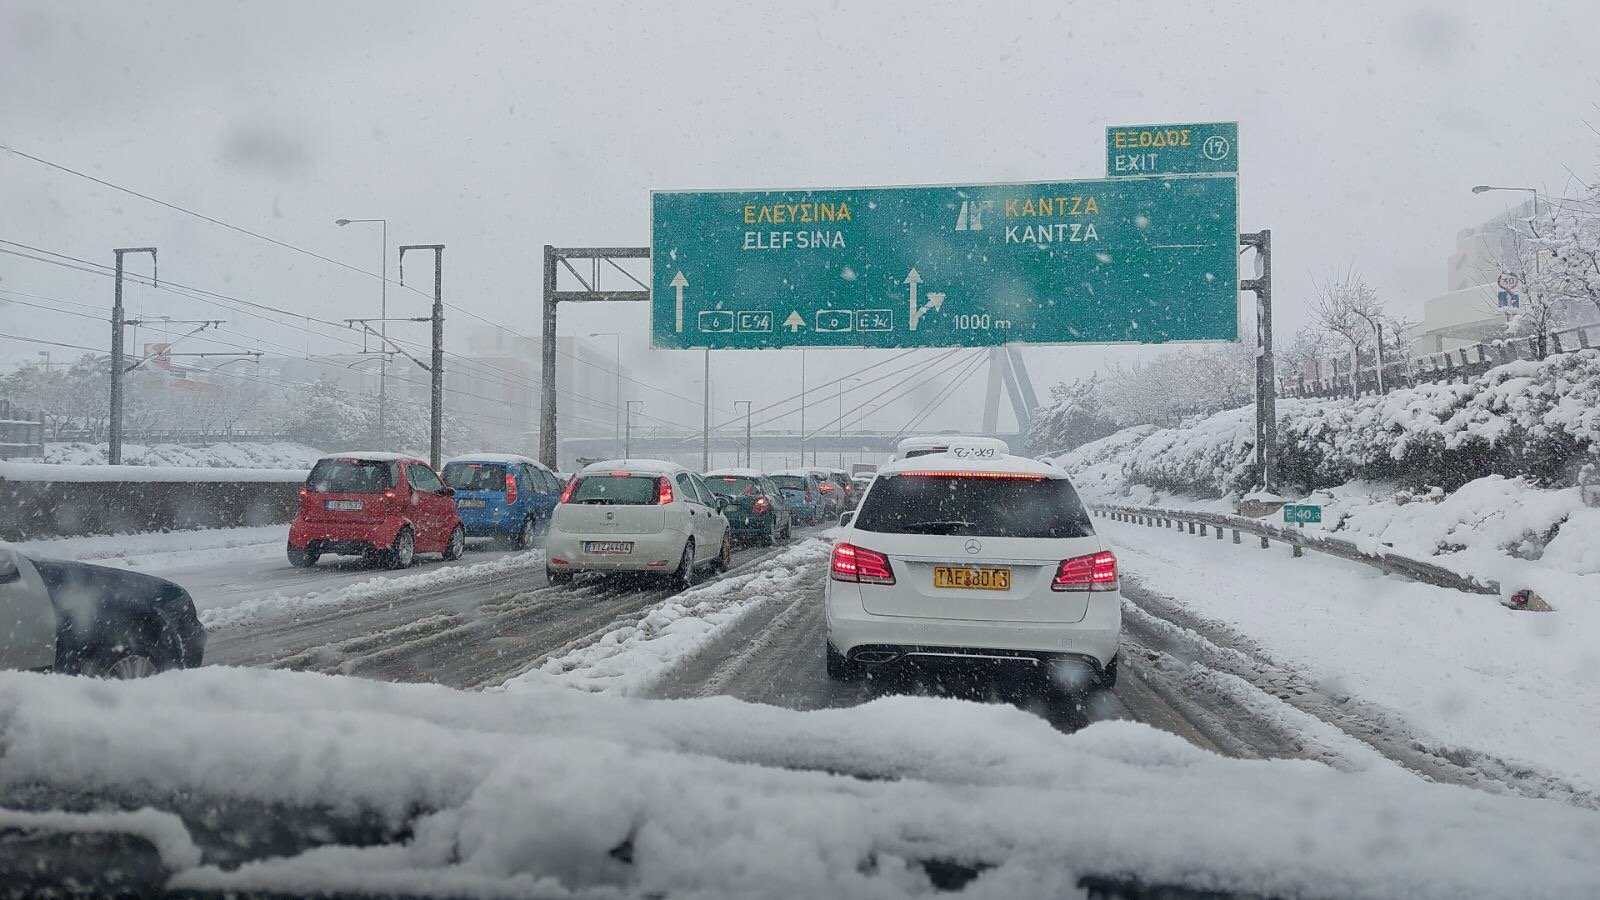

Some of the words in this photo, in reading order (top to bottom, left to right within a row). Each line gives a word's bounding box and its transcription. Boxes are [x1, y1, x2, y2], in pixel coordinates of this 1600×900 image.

[1115, 129, 1192, 149] ΕΞΟΔΟΣ
[1208, 141, 1224, 155] 17
[1115, 153, 1159, 171] EXIT
[744, 202, 852, 224] ΕΛΕΥΣΙΝΑ
[1005, 196, 1099, 217] ΚΑΝΤΖΑ
[743, 230, 847, 250] ELEFSINA
[1005, 222, 1100, 243] KANTZA
[712, 316, 720, 328] 6
[954, 314, 990, 330] 1000
[995, 319, 1011, 329] m
